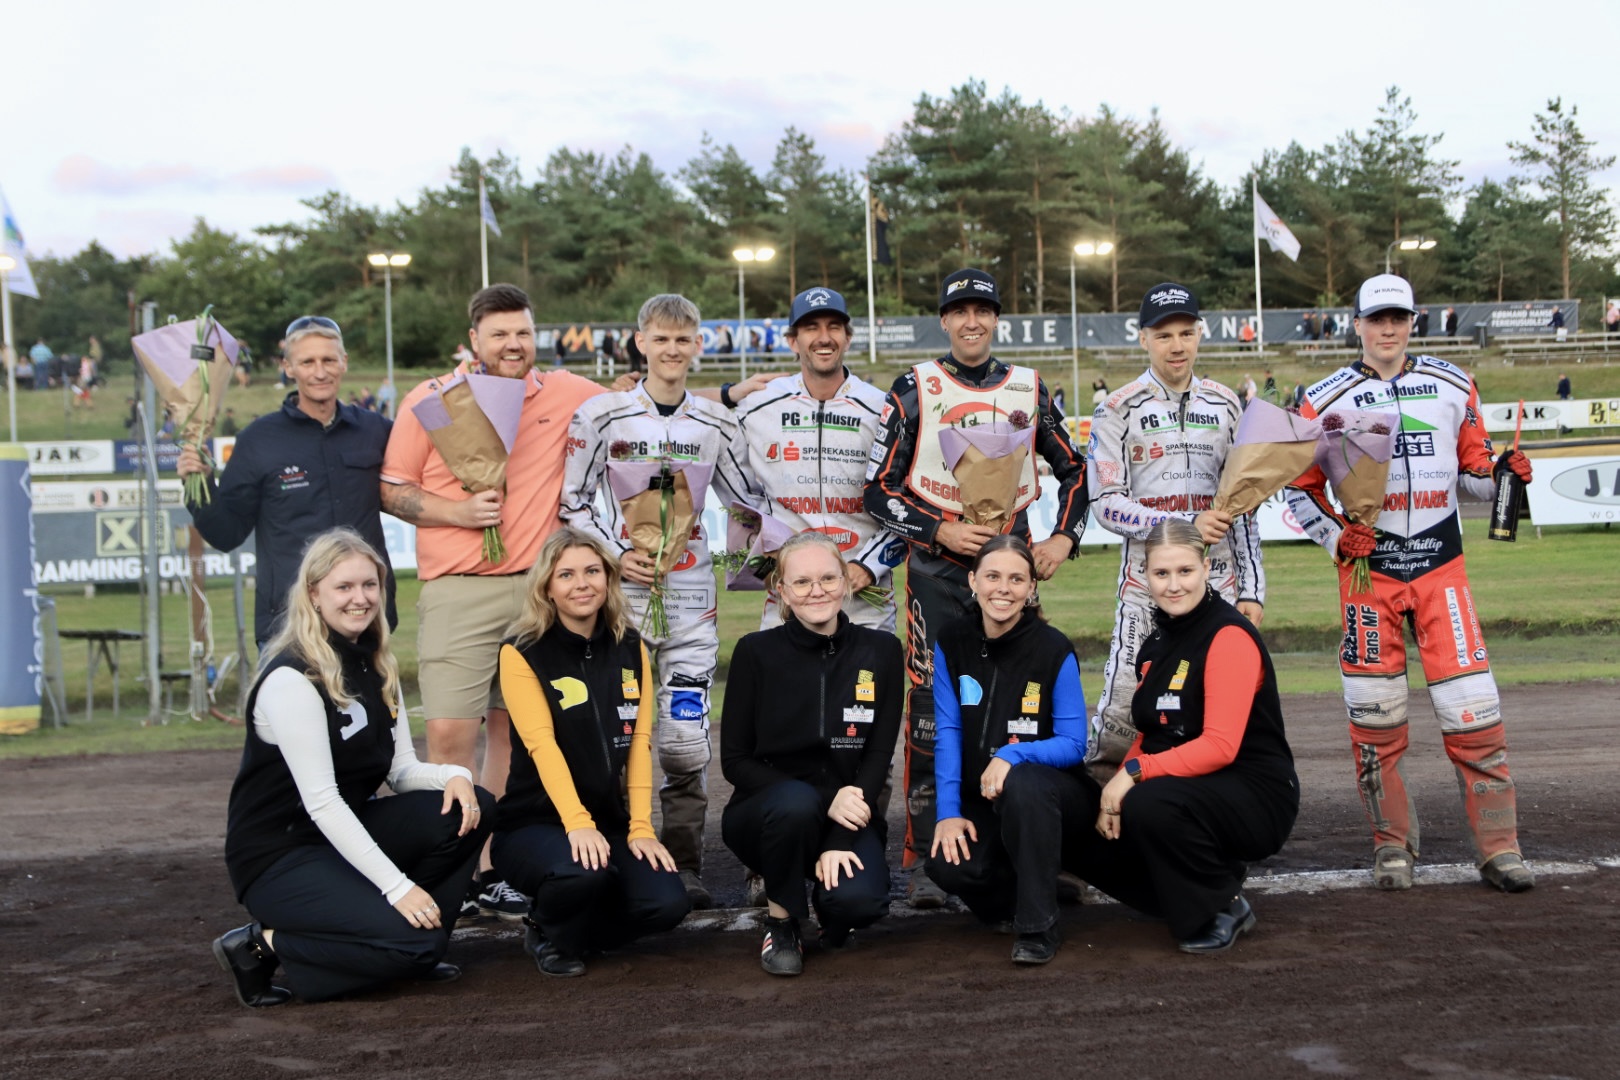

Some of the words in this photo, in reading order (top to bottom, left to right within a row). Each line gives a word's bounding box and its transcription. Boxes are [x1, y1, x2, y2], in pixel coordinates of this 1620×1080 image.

[926, 376, 943, 395] 3
[1307, 371, 1349, 398] NORICK
[1353, 391, 1376, 408] PG
[781, 412, 801, 427] PG
[1140, 413, 1160, 430] PG
[34, 446, 82, 462] JAK
[631, 441, 648, 456] PG
[766, 443, 779, 460] 4
[802, 447, 867, 458] SPAREKASSEN
[1132, 445, 1145, 461] 2
[797, 475, 828, 484] Cloud
[1419, 469, 1451, 480] Factory
[920, 475, 961, 502] REGI
[825, 497, 864, 514] VARDE
[1412, 490, 1449, 510] VARDE
[1103, 507, 1140, 526] REMA
[1375, 540, 1400, 552] alle
[1403, 537, 1443, 552] Phillip
[1381, 558, 1430, 571] Transport
[1361, 605, 1378, 628] MF
[1448, 602, 1469, 665] AXELGAARD
[1363, 630, 1381, 666] Trans
[680, 708, 702, 718] Nice
[1104, 721, 1115, 732] CB
